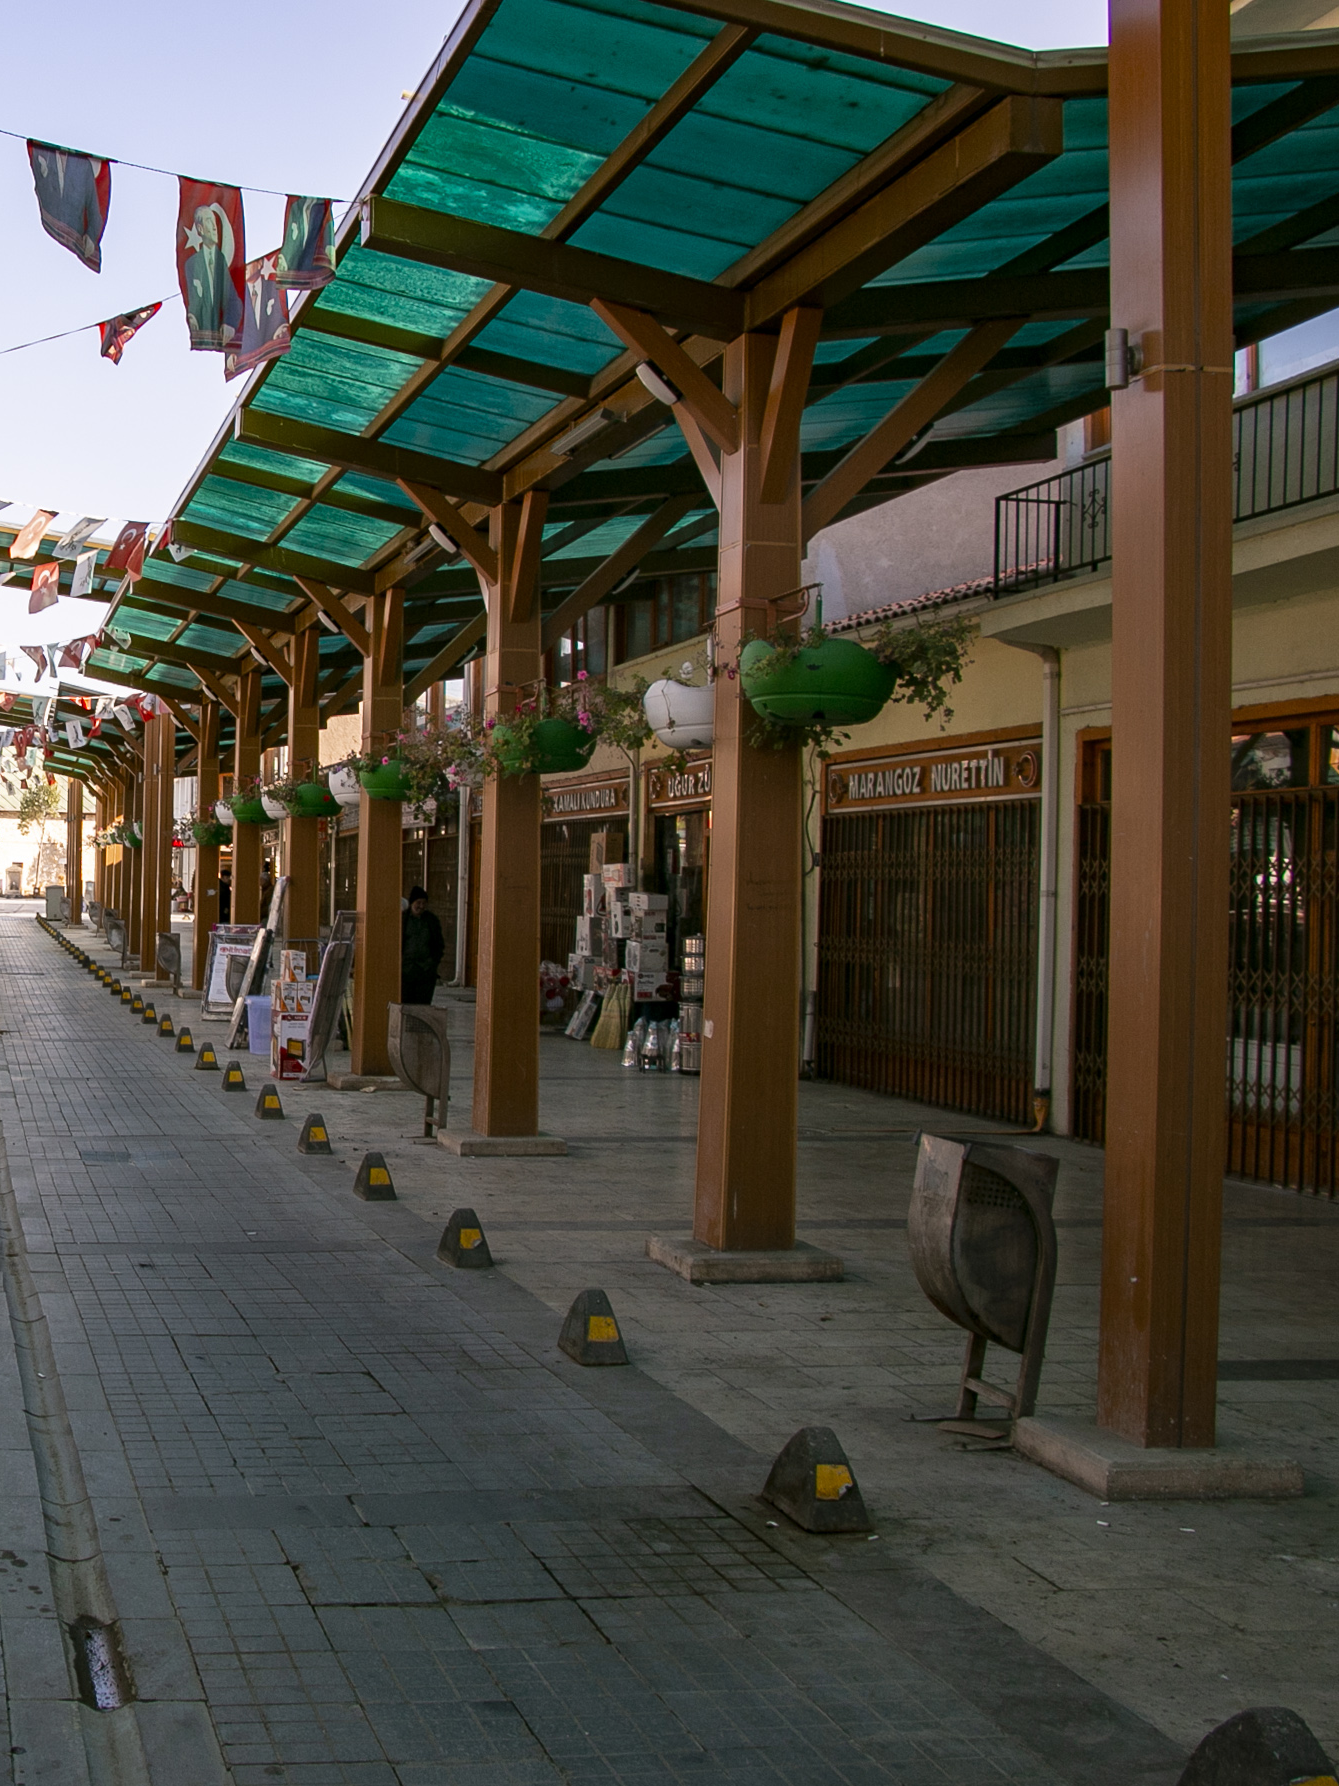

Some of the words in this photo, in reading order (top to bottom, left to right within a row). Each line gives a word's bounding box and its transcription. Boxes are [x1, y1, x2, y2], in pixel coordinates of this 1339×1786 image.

[848, 766, 922, 800] MARANGOZ
[930, 749, 1005, 793] NURETTİN
[581, 788, 616, 810] KUNDURA
